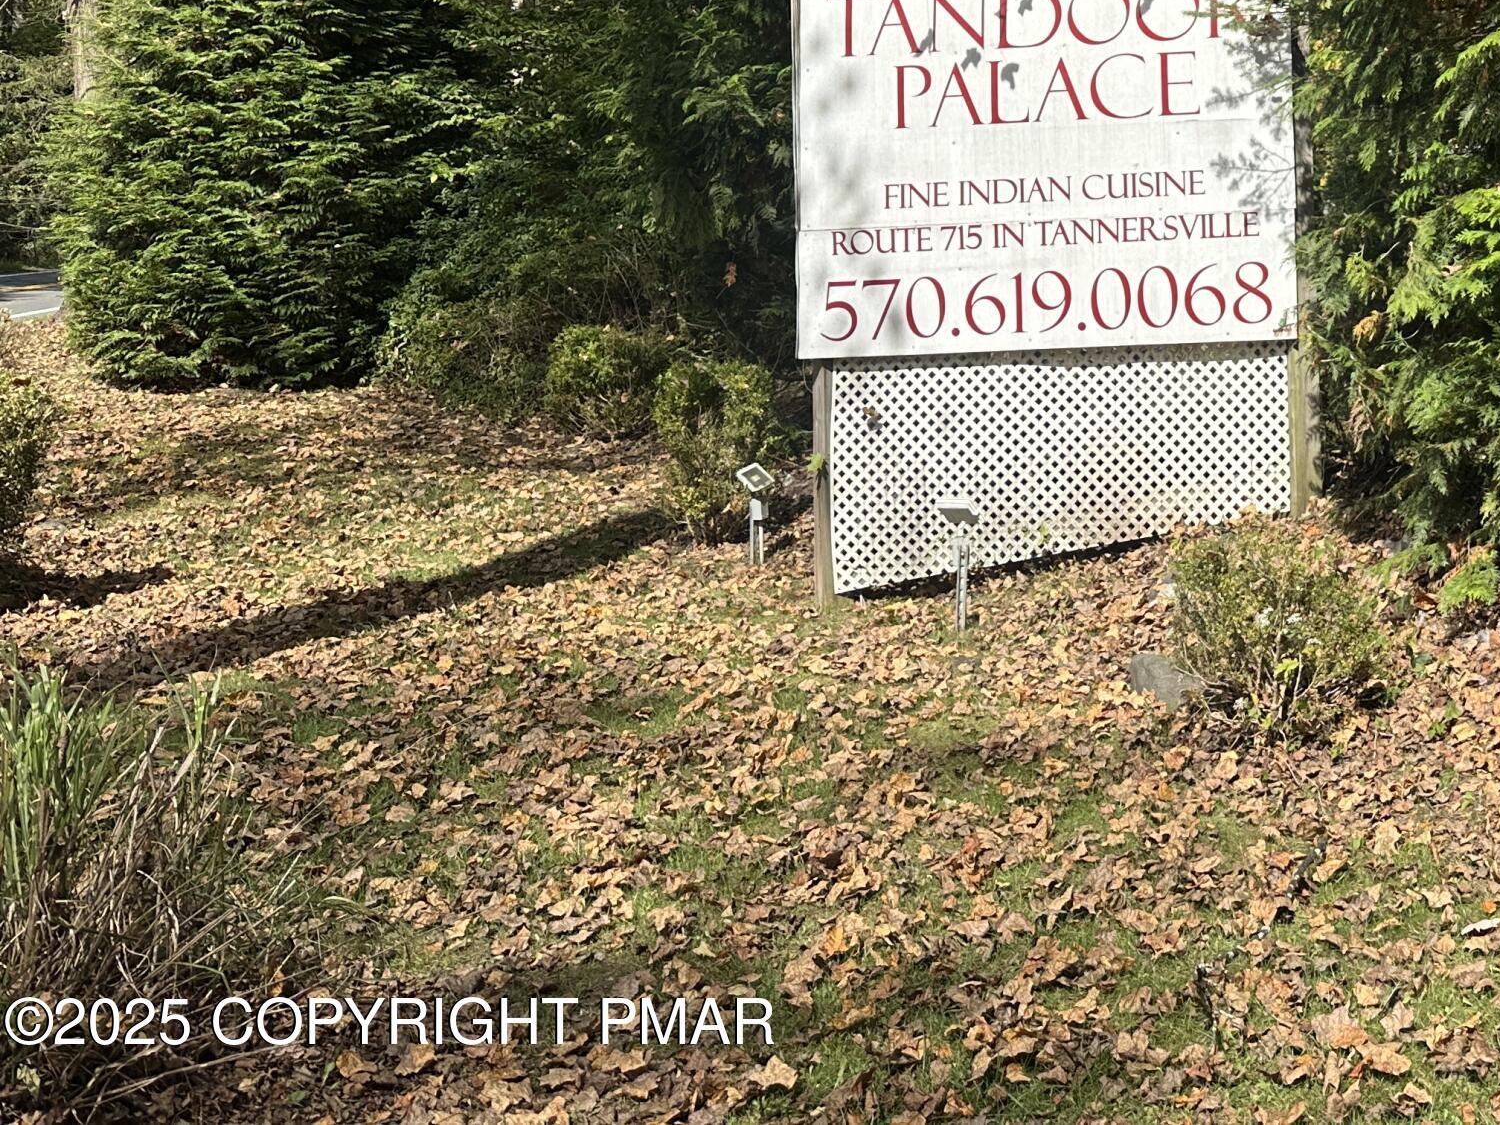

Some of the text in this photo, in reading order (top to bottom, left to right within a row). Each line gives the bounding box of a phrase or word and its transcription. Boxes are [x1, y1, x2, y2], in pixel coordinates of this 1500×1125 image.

[893, 50, 1201, 130] PALACE
[883, 170, 1206, 209] FINE INDIAN CUISINE
[831, 212, 1260, 256] ROUTE 715 IN TANNERSVILLE
[820, 261, 1273, 342] 570.619.0068
